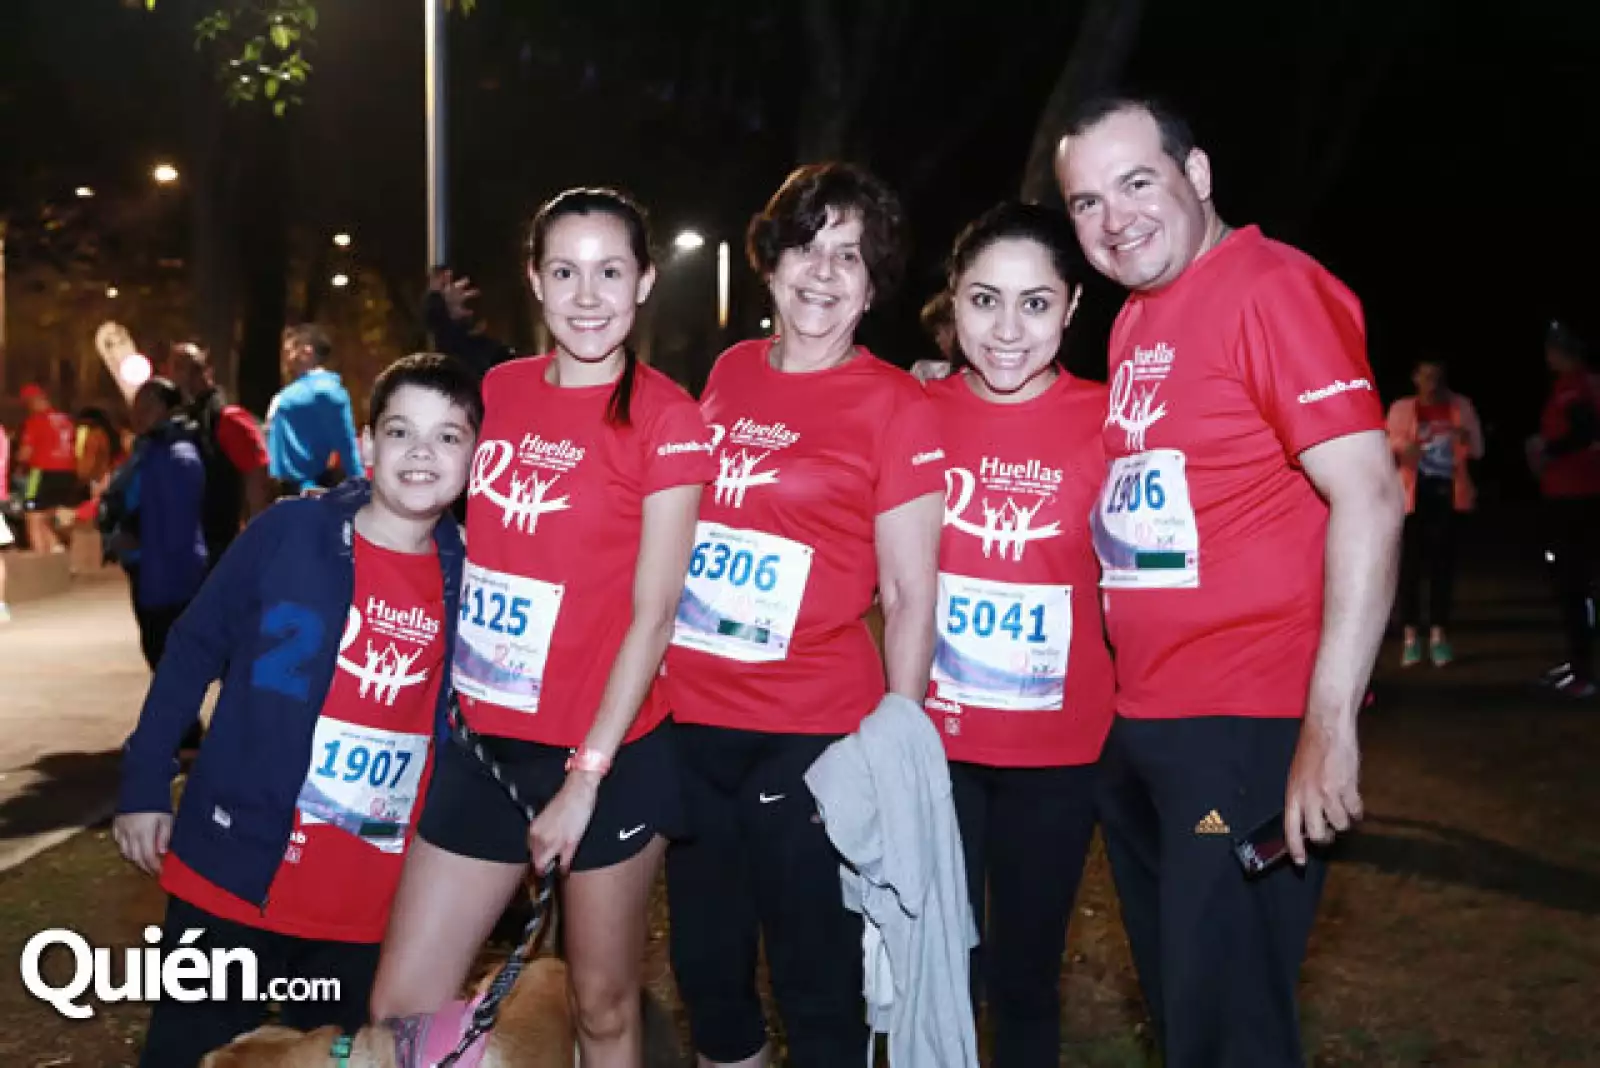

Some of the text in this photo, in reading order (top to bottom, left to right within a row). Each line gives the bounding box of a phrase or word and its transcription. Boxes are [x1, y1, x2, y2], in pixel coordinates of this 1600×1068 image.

[519, 432, 586, 462] Huellas
[979, 455, 1063, 483] Huellas
[689, 541, 781, 592] 6306
[366, 595, 441, 634] Huellas
[946, 594, 1047, 644] 5041
[252, 602, 326, 698] 2
[314, 738, 413, 790] 1907
